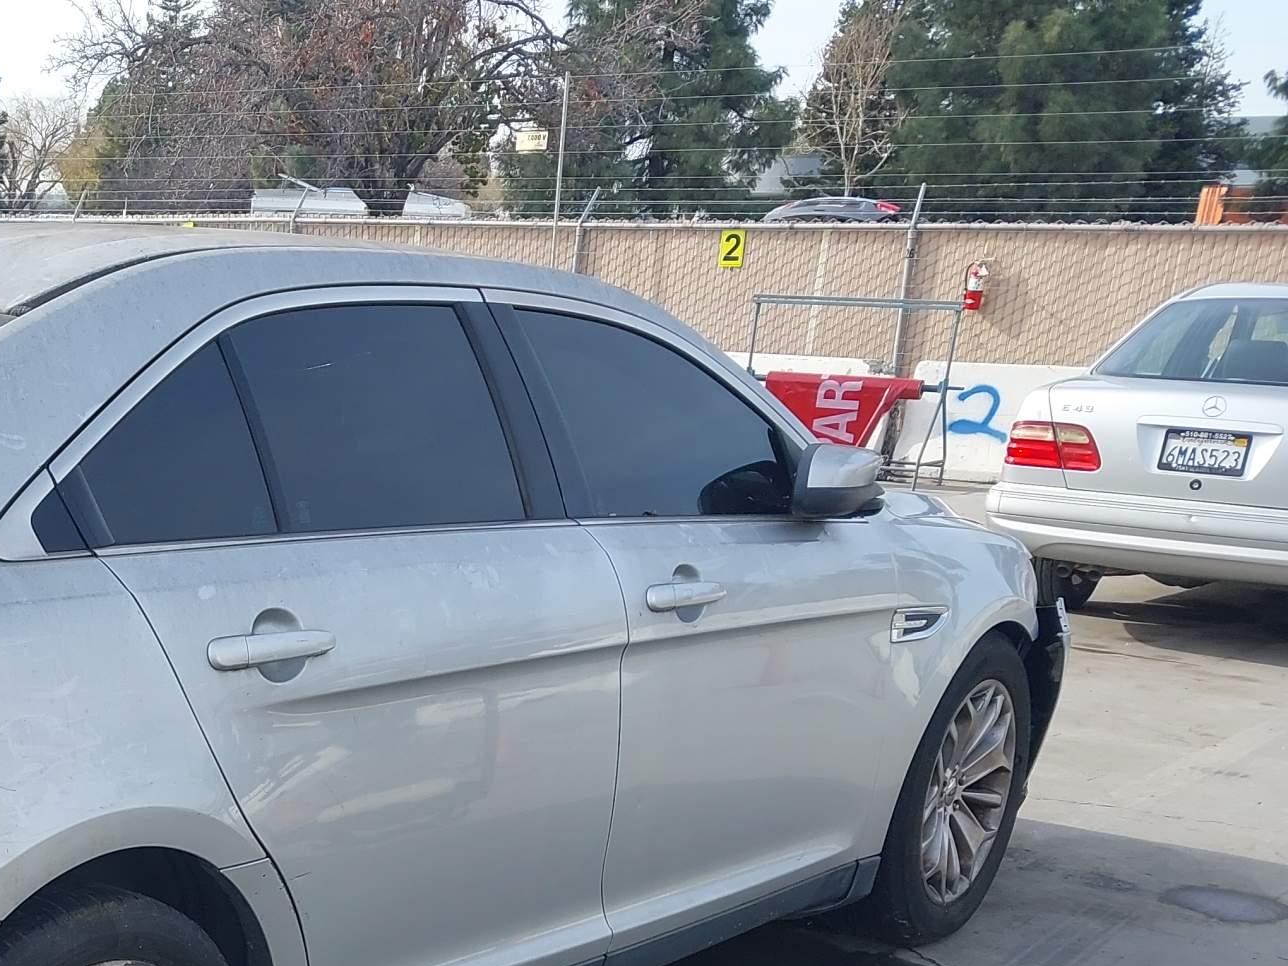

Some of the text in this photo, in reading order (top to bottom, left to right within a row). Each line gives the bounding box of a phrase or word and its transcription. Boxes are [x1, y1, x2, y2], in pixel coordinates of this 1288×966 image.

[722, 233, 742, 261] 2
[812, 374, 864, 444] AR
[947, 384, 1008, 444] 2
[1165, 445, 1241, 470] 6MAS523
